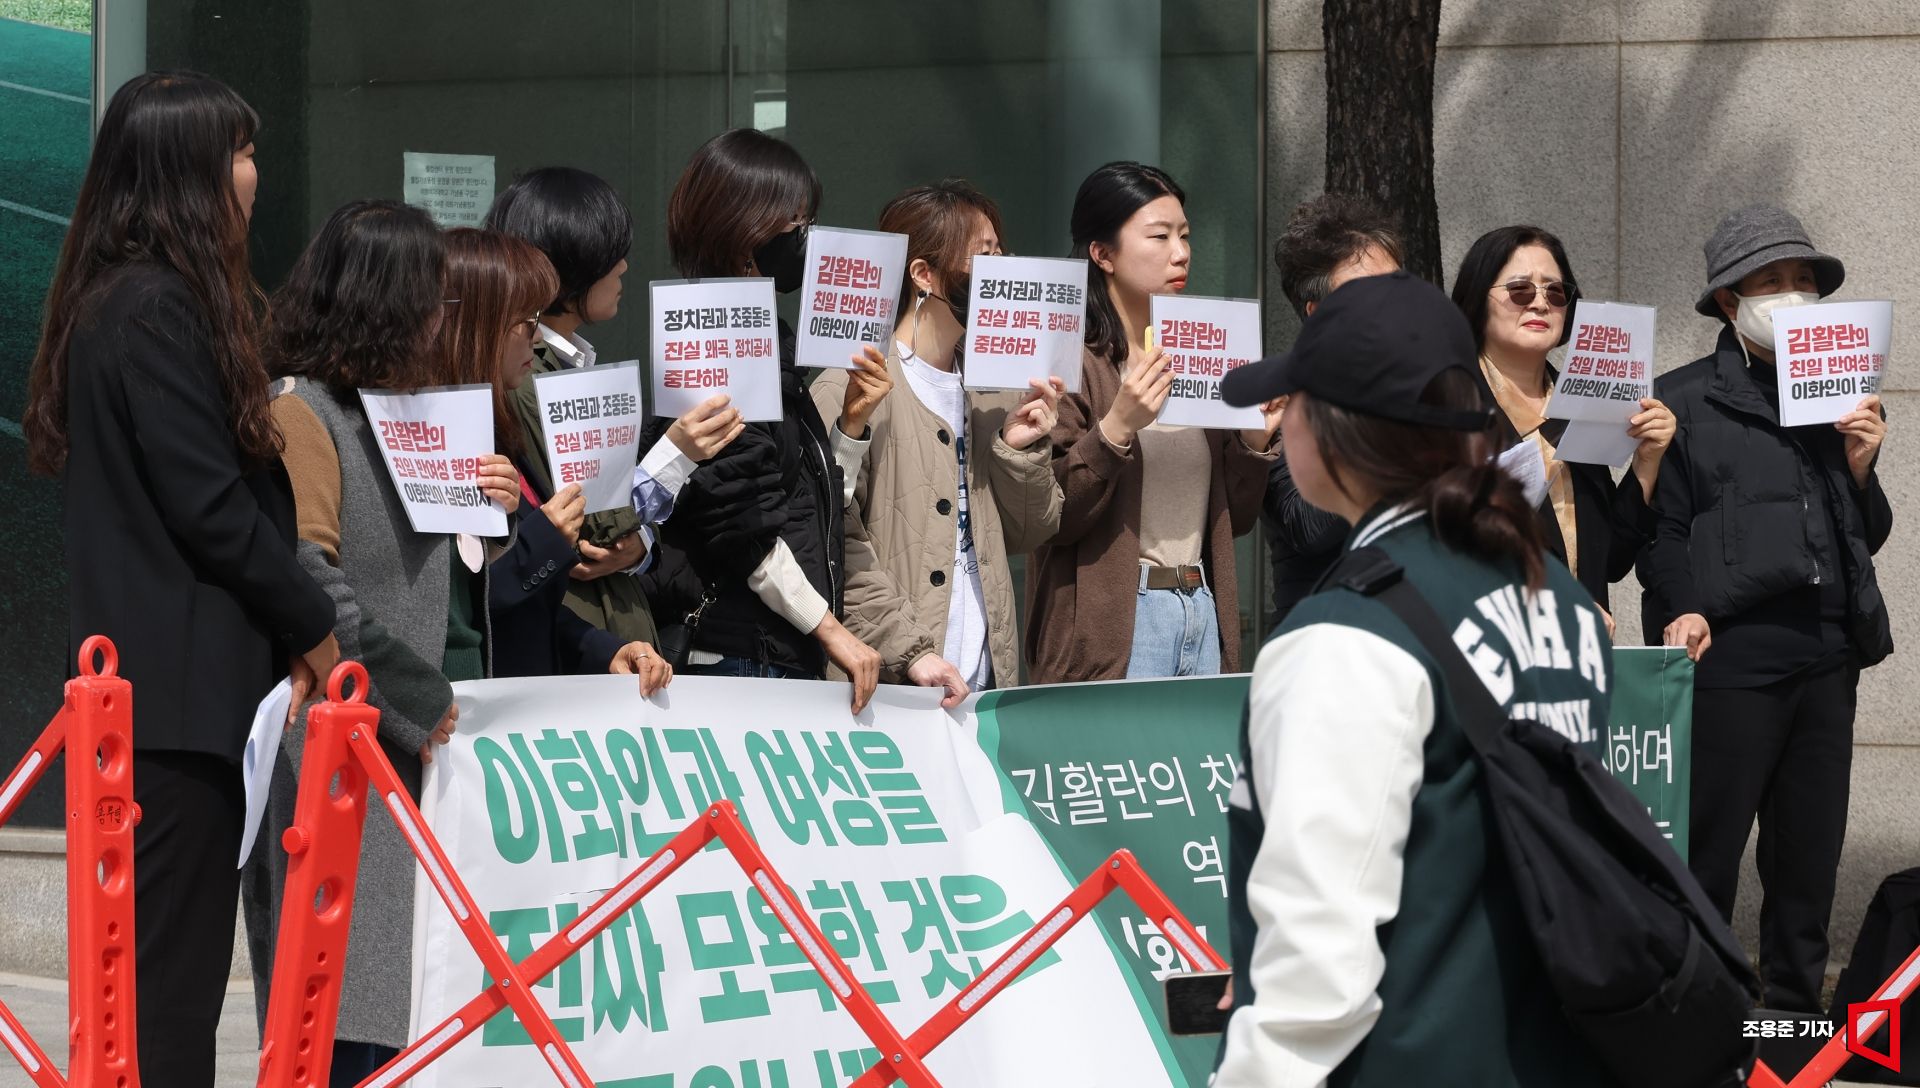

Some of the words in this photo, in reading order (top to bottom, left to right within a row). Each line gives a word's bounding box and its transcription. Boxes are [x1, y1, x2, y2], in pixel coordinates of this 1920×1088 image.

[817, 255, 882, 289] 김활란의
[813, 290, 837, 313] 친일
[840, 293, 877, 317] 반여성
[979, 279, 1043, 302] 정치권과
[1045, 282, 1082, 305] 조중동은
[663, 307, 728, 332] 정치권과
[730, 306, 771, 328] 조중동은
[809, 316, 859, 340] 이화인이
[977, 308, 1009, 328] 진실
[1011, 310, 1043, 331] 왜곡,
[1048, 312, 1080, 334] 정치공세
[974, 334, 1036, 356] 중단하라
[1161, 319, 1227, 351] 김활란의
[1575, 324, 1631, 353] 김활란의
[1788, 323, 1870, 355] 김활란의
[664, 340, 701, 361] 진실
[705, 338, 732, 359] 왜곡,
[735, 337, 772, 358] 정치공세
[663, 367, 728, 389] 중단하라
[1189, 355, 1223, 377] 반여성
[1567, 355, 1594, 375] 친일
[1595, 358, 1628, 378] 반여성
[1629, 361, 1645, 380] 행위
[1789, 358, 1822, 379] 친일
[1828, 354, 1870, 374] 반여성
[1561, 377, 1611, 399] 이화인이
[1792, 377, 1857, 400] 이화인이
[547, 396, 601, 424] 정치권과
[602, 391, 637, 418] 조중동은
[379, 420, 447, 453] 김활란의
[554, 431, 580, 455] 진실
[582, 427, 604, 451] 왜곡,
[606, 423, 637, 449] 정치공세
[392, 456, 417, 478] 친일
[416, 458, 450, 480] 반여성
[450, 457, 481, 481] 행위
[560, 458, 601, 483] 중단하라
[403, 483, 447, 505] 이화인이
[1451, 582, 1607, 706] EWHA
[1011, 756, 1196, 826] 김활란의
[1200, 753, 1235, 814] 친
[1602, 723, 1672, 785] 하며
[473, 726, 758, 864] 이화인과
[745, 730, 948, 846] 여성을
